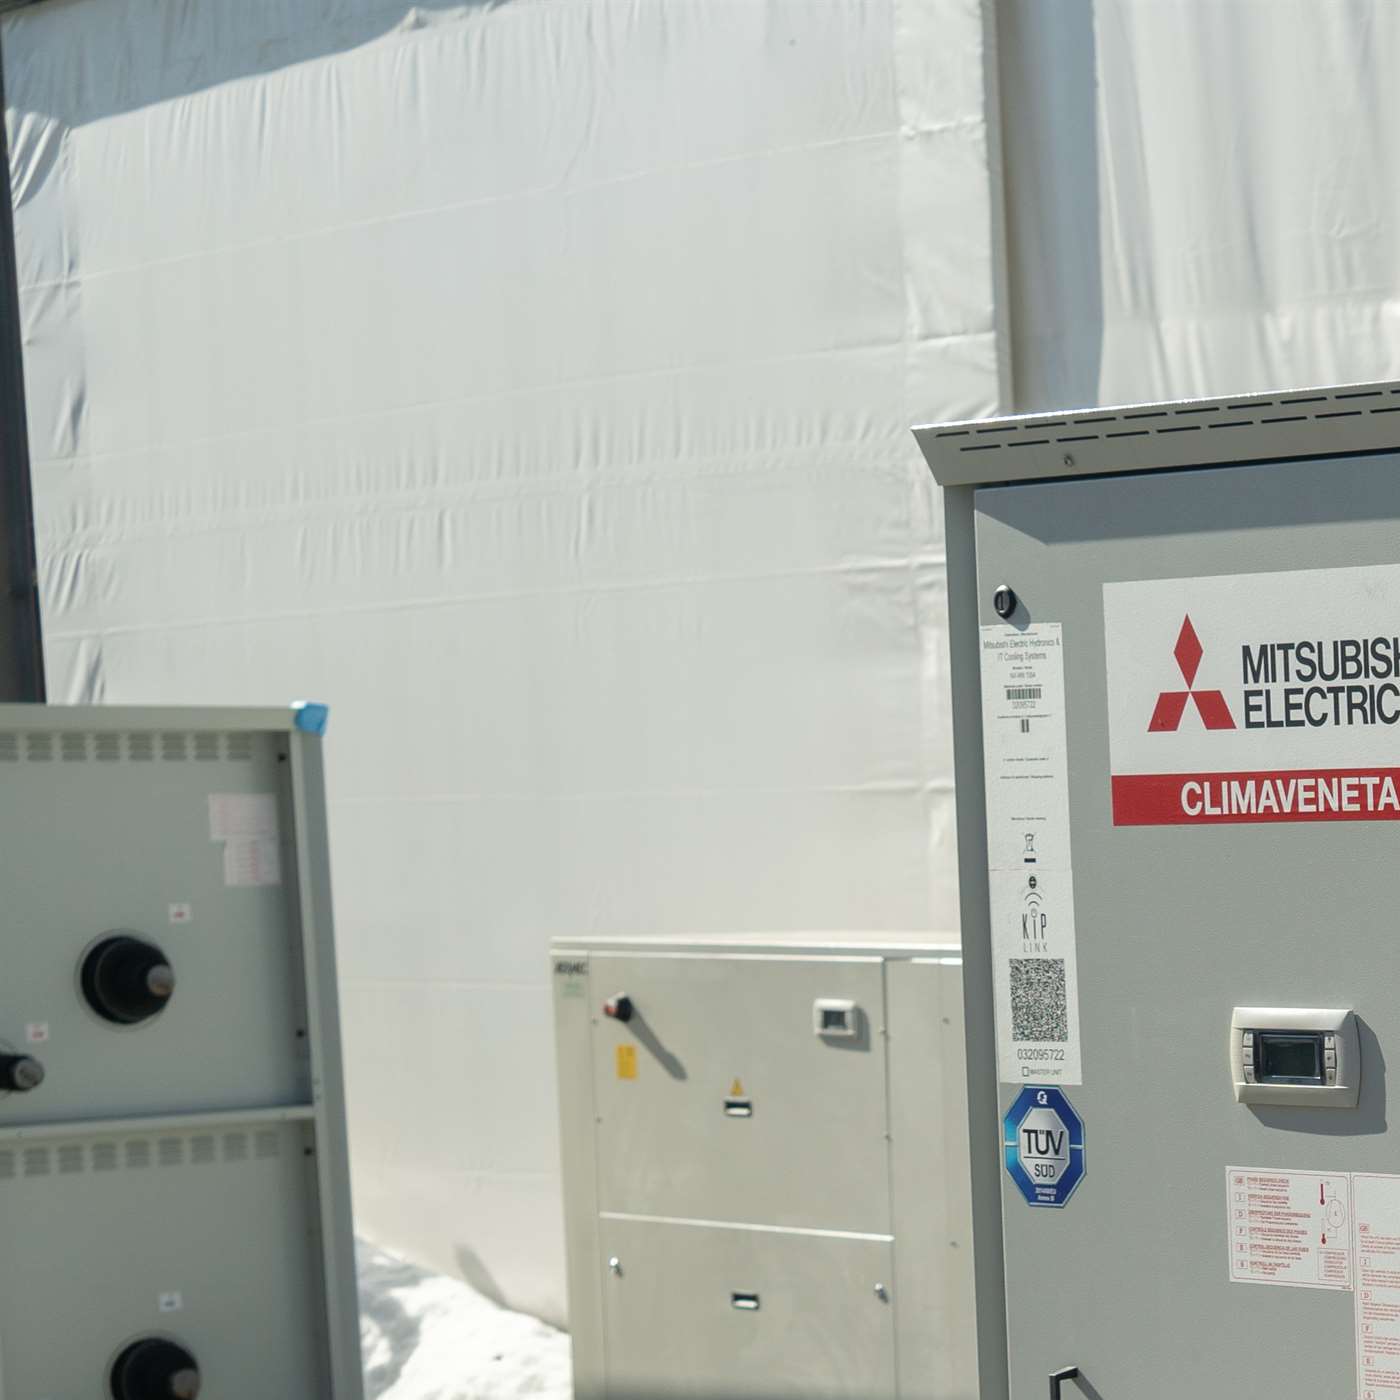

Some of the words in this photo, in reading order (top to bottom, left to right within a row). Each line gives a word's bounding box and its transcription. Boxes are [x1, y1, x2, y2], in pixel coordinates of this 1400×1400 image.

[1244, 682, 1400, 729] ELECTRIC
[1180, 776, 1400, 816] CLIMAVENETA
[1023, 942, 1048, 953] LINK
[1016, 1048, 1065, 1061] 032095722
[1022, 1128, 1064, 1156] TÜV
